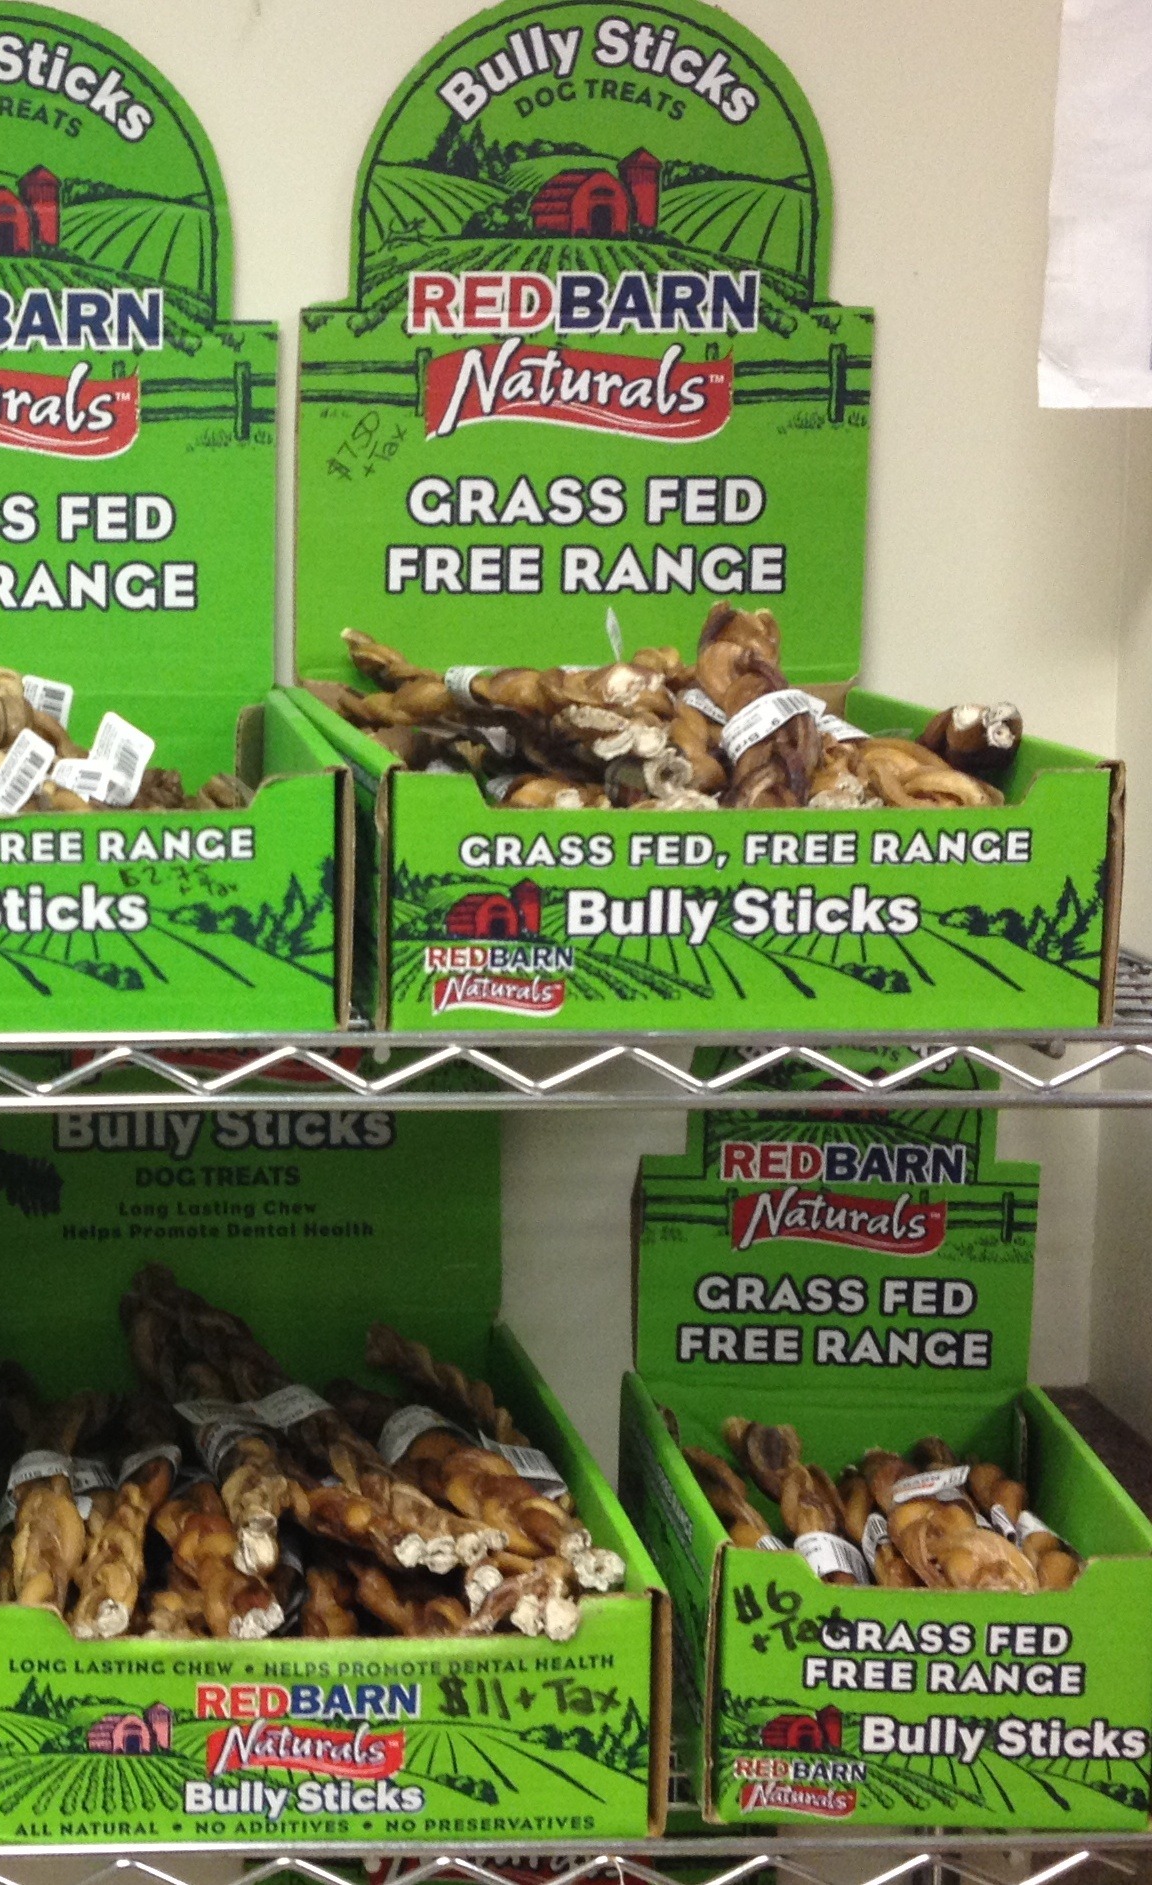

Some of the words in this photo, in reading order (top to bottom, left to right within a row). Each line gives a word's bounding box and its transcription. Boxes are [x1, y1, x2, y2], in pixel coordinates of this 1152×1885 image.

[439, 24, 580, 122] Bully
[594, 19, 759, 124] Sticks
[514, 81, 577, 119] DOG
[586, 79, 687, 121] TREATS
[408, 271, 760, 334] REDBARN
[368, 423, 407, 462] Tax
[59, 494, 175, 542] FED
[409, 476, 625, 526] GRASS
[646, 477, 766, 525] FED
[386, 545, 542, 594] FREE
[563, 545, 786, 594] RANGE
[98, 826, 256, 862] RANGE
[458, 833, 613, 868] GRASS
[743, 831, 858, 866] FREE
[870, 828, 1033, 866] RANGE
[565, 889, 719, 947] Bully
[731, 887, 921, 938] Sticks
[424, 945, 574, 972] REDBARN
[55, 1111, 201, 1159] Bully
[214, 1111, 395, 1151] Sticks
[136, 1167, 196, 1187] DOG
[201, 1166, 301, 1187] TREATS
[721, 1141, 966, 1185] REDBARN
[119, 1202, 168, 1218] Long
[177, 1201, 256, 1217] Lasting
[263, 1201, 316, 1216] Chew
[63, 1224, 122, 1241] Helps
[129, 1223, 219, 1239] Promote
[227, 1222, 296, 1238] Dental
[303, 1221, 374, 1238] Health
[696, 1274, 866, 1314] GRASS
[881, 1277, 977, 1316] FED
[678, 1324, 802, 1364] FREE
[815, 1327, 992, 1368] RANGE
[821, 1620, 976, 1656] GRASS
[986, 1623, 1072, 1657] FED
[8, 1660, 69, 1675] LONG
[74, 1660, 166, 1676] LASTING
[172, 1661, 233, 1677] CHEW
[264, 1662, 330, 1678] HELPS
[337, 1660, 442, 1678] PROMOTE
[449, 1657, 529, 1676] DENTAL
[535, 1653, 615, 1672] HEALTH
[804, 1657, 918, 1692] FREE
[926, 1661, 1085, 1695] RANGE
[195, 1683, 421, 1719] REDBARN
[542, 1679, 623, 1715] Tax
[861, 1715, 987, 1763] Bully
[996, 1718, 1148, 1760] Sticks
[734, 1757, 868, 1782] REDBARN
[184, 1782, 290, 1819] Bully
[298, 1780, 424, 1814] Sticks
[15, 1822, 50, 1836] ALL
[58, 1821, 160, 1836] NATURAL
[194, 1820, 224, 1835] NO
[232, 1820, 350, 1835] ADDITIVES
[385, 1818, 415, 1833] NO
[421, 1816, 596, 1833] PRESERVATIVES
